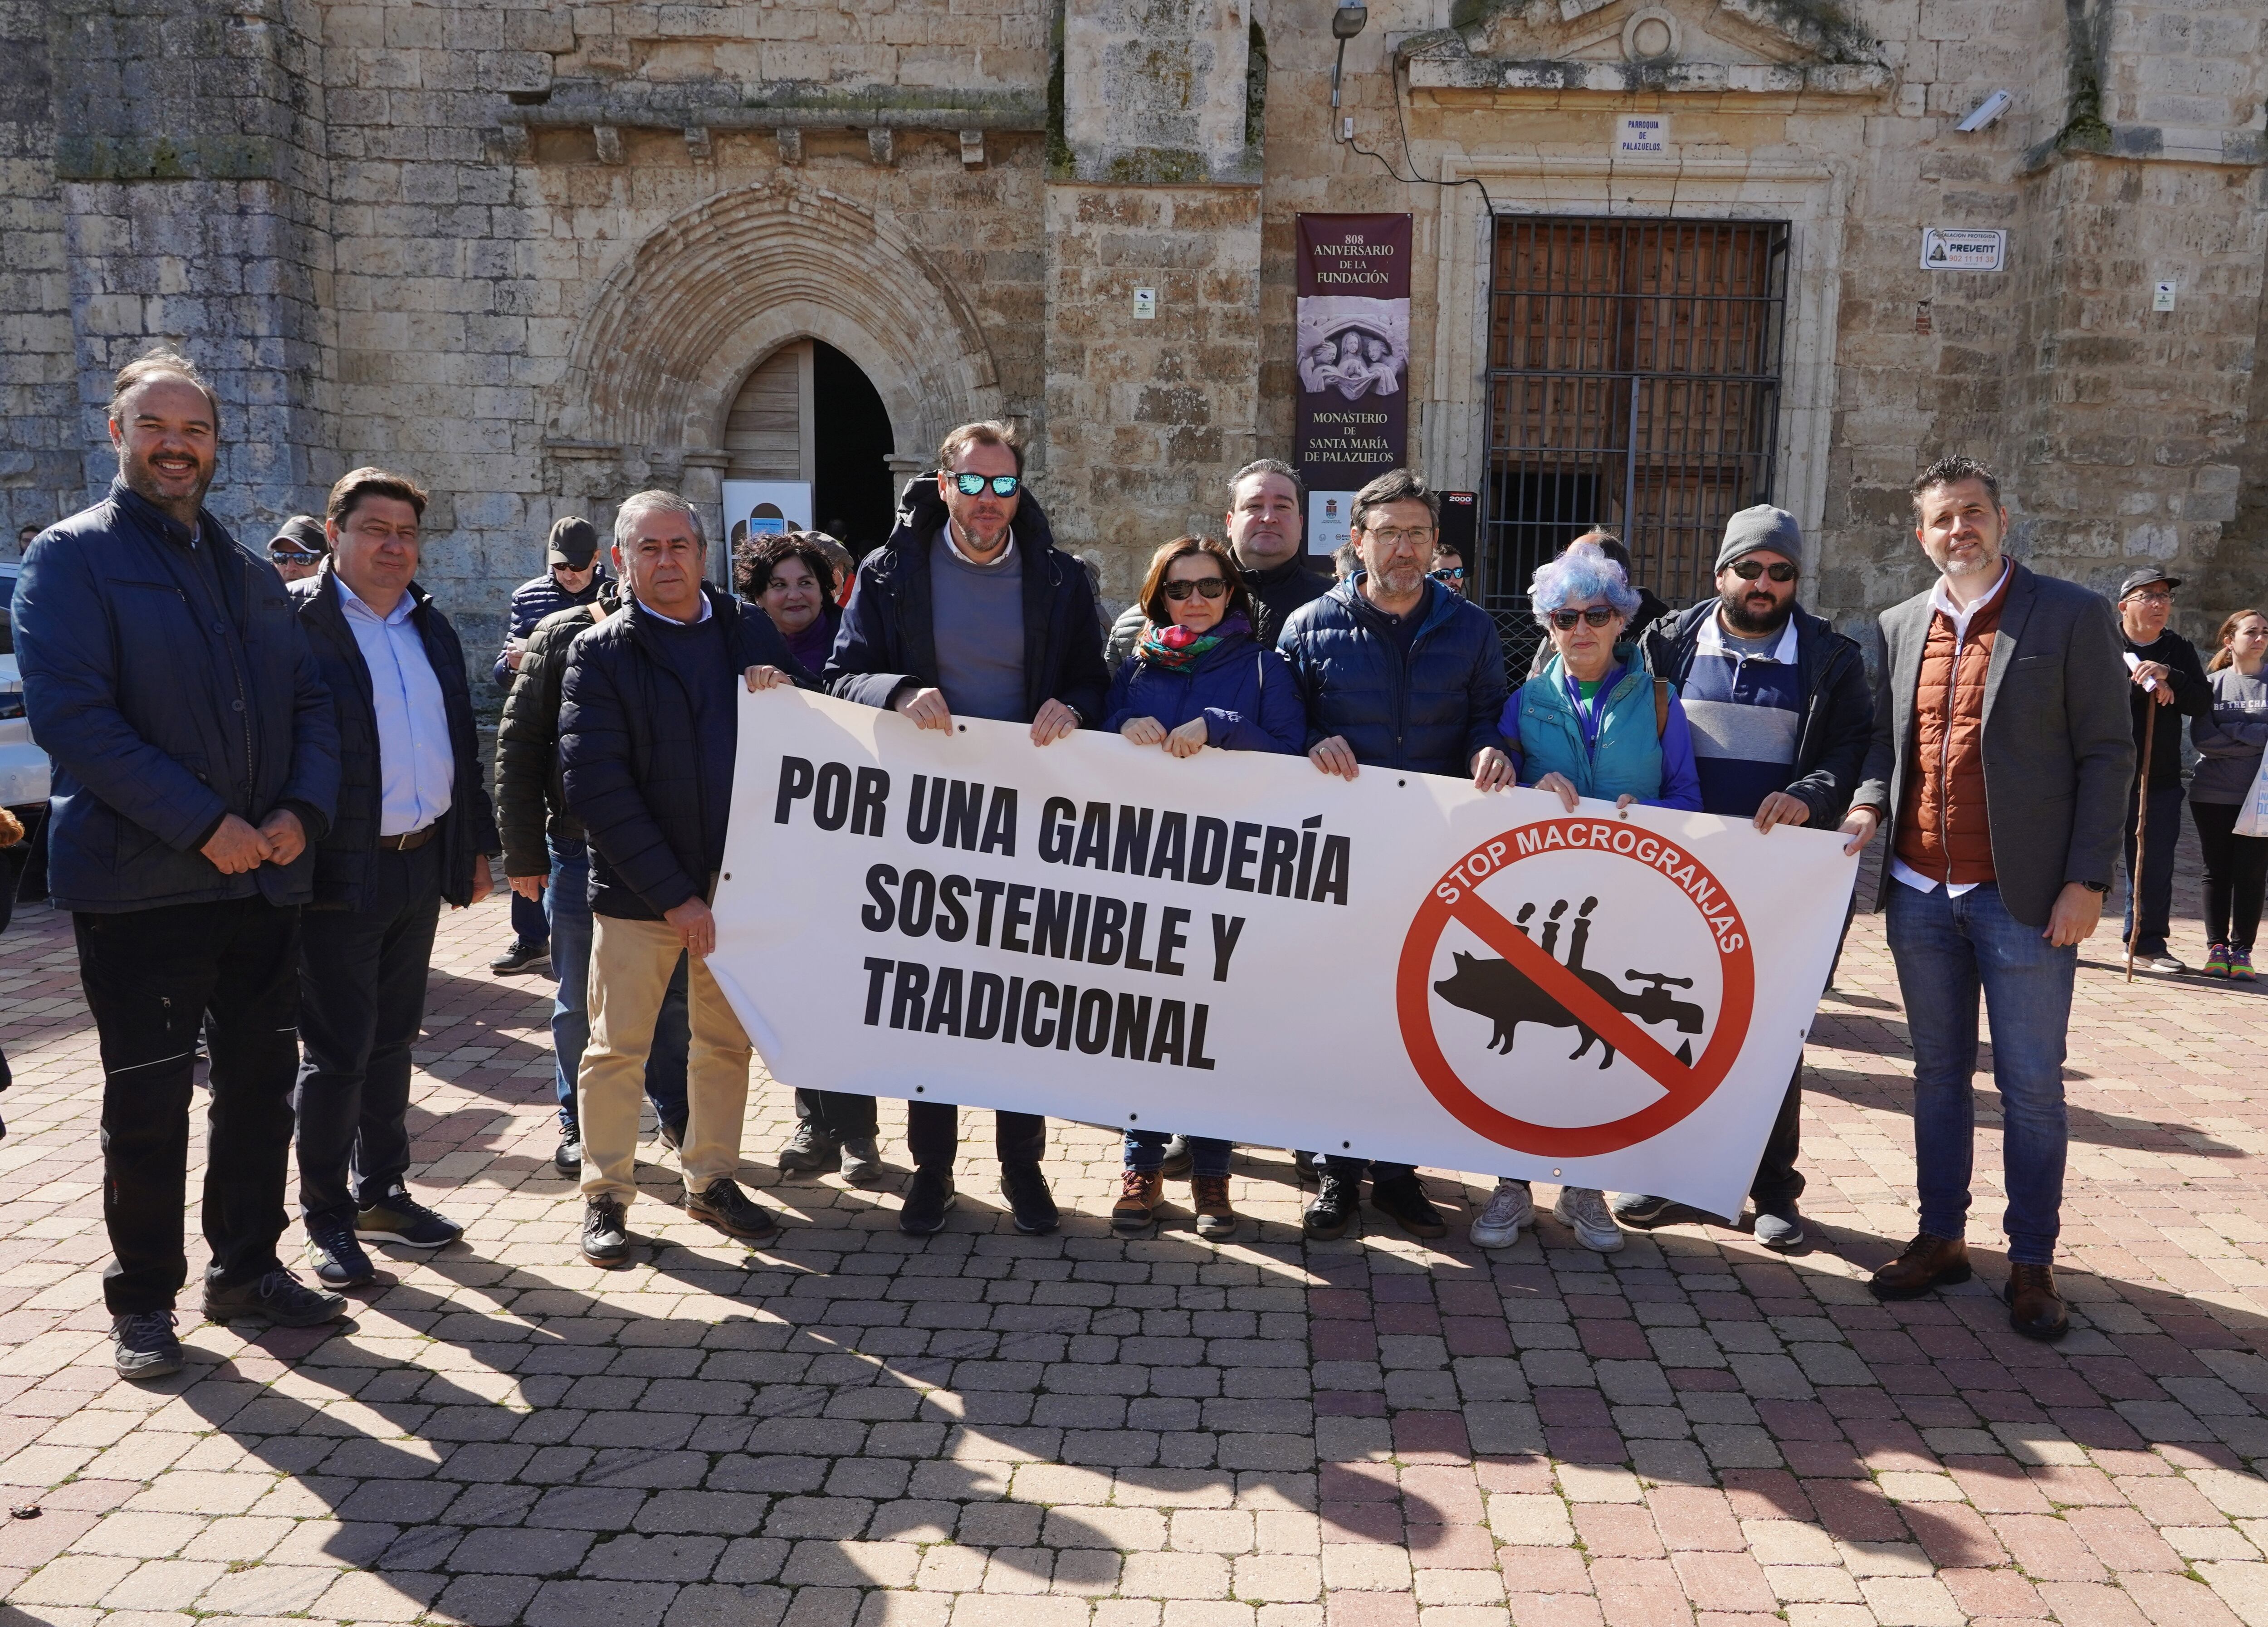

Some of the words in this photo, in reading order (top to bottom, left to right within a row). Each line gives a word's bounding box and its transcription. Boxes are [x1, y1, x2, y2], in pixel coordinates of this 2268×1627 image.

[1628, 121, 1659, 129] PARROQUIA
[1639, 132, 1647, 140] DE
[1623, 142, 1662, 151] PALAZUELOS.
[1345, 235, 1364, 244] 808
[1314, 245, 1394, 256] ANIVERSARIO
[1950, 244, 1995, 253] PREVENT
[1339, 260, 1352, 269] DE
[1354, 260, 1367, 269] LA
[1317, 270, 1389, 283] FUNDACIÓN
[1313, 413, 1388, 424] MONASTERIO
[1344, 426, 1356, 435] DE
[1310, 438, 1346, 449] SANTA
[1350, 436, 1388, 449] MARÍA
[1305, 452, 1320, 462] DE
[1322, 452, 1393, 463] PALAZUELOS
[775, 756, 890, 837] POR
[906, 774, 1018, 857] UNA
[1037, 796, 1351, 906] GANADERÍA
[1436, 841, 1507, 905] STOP
[1516, 823, 1745, 955] MACROGRANJAS
[861, 863, 1190, 976] SOSTENIBLE
[1211, 913, 1246, 982] Y
[863, 956, 1216, 1070] TRADICIONAL
